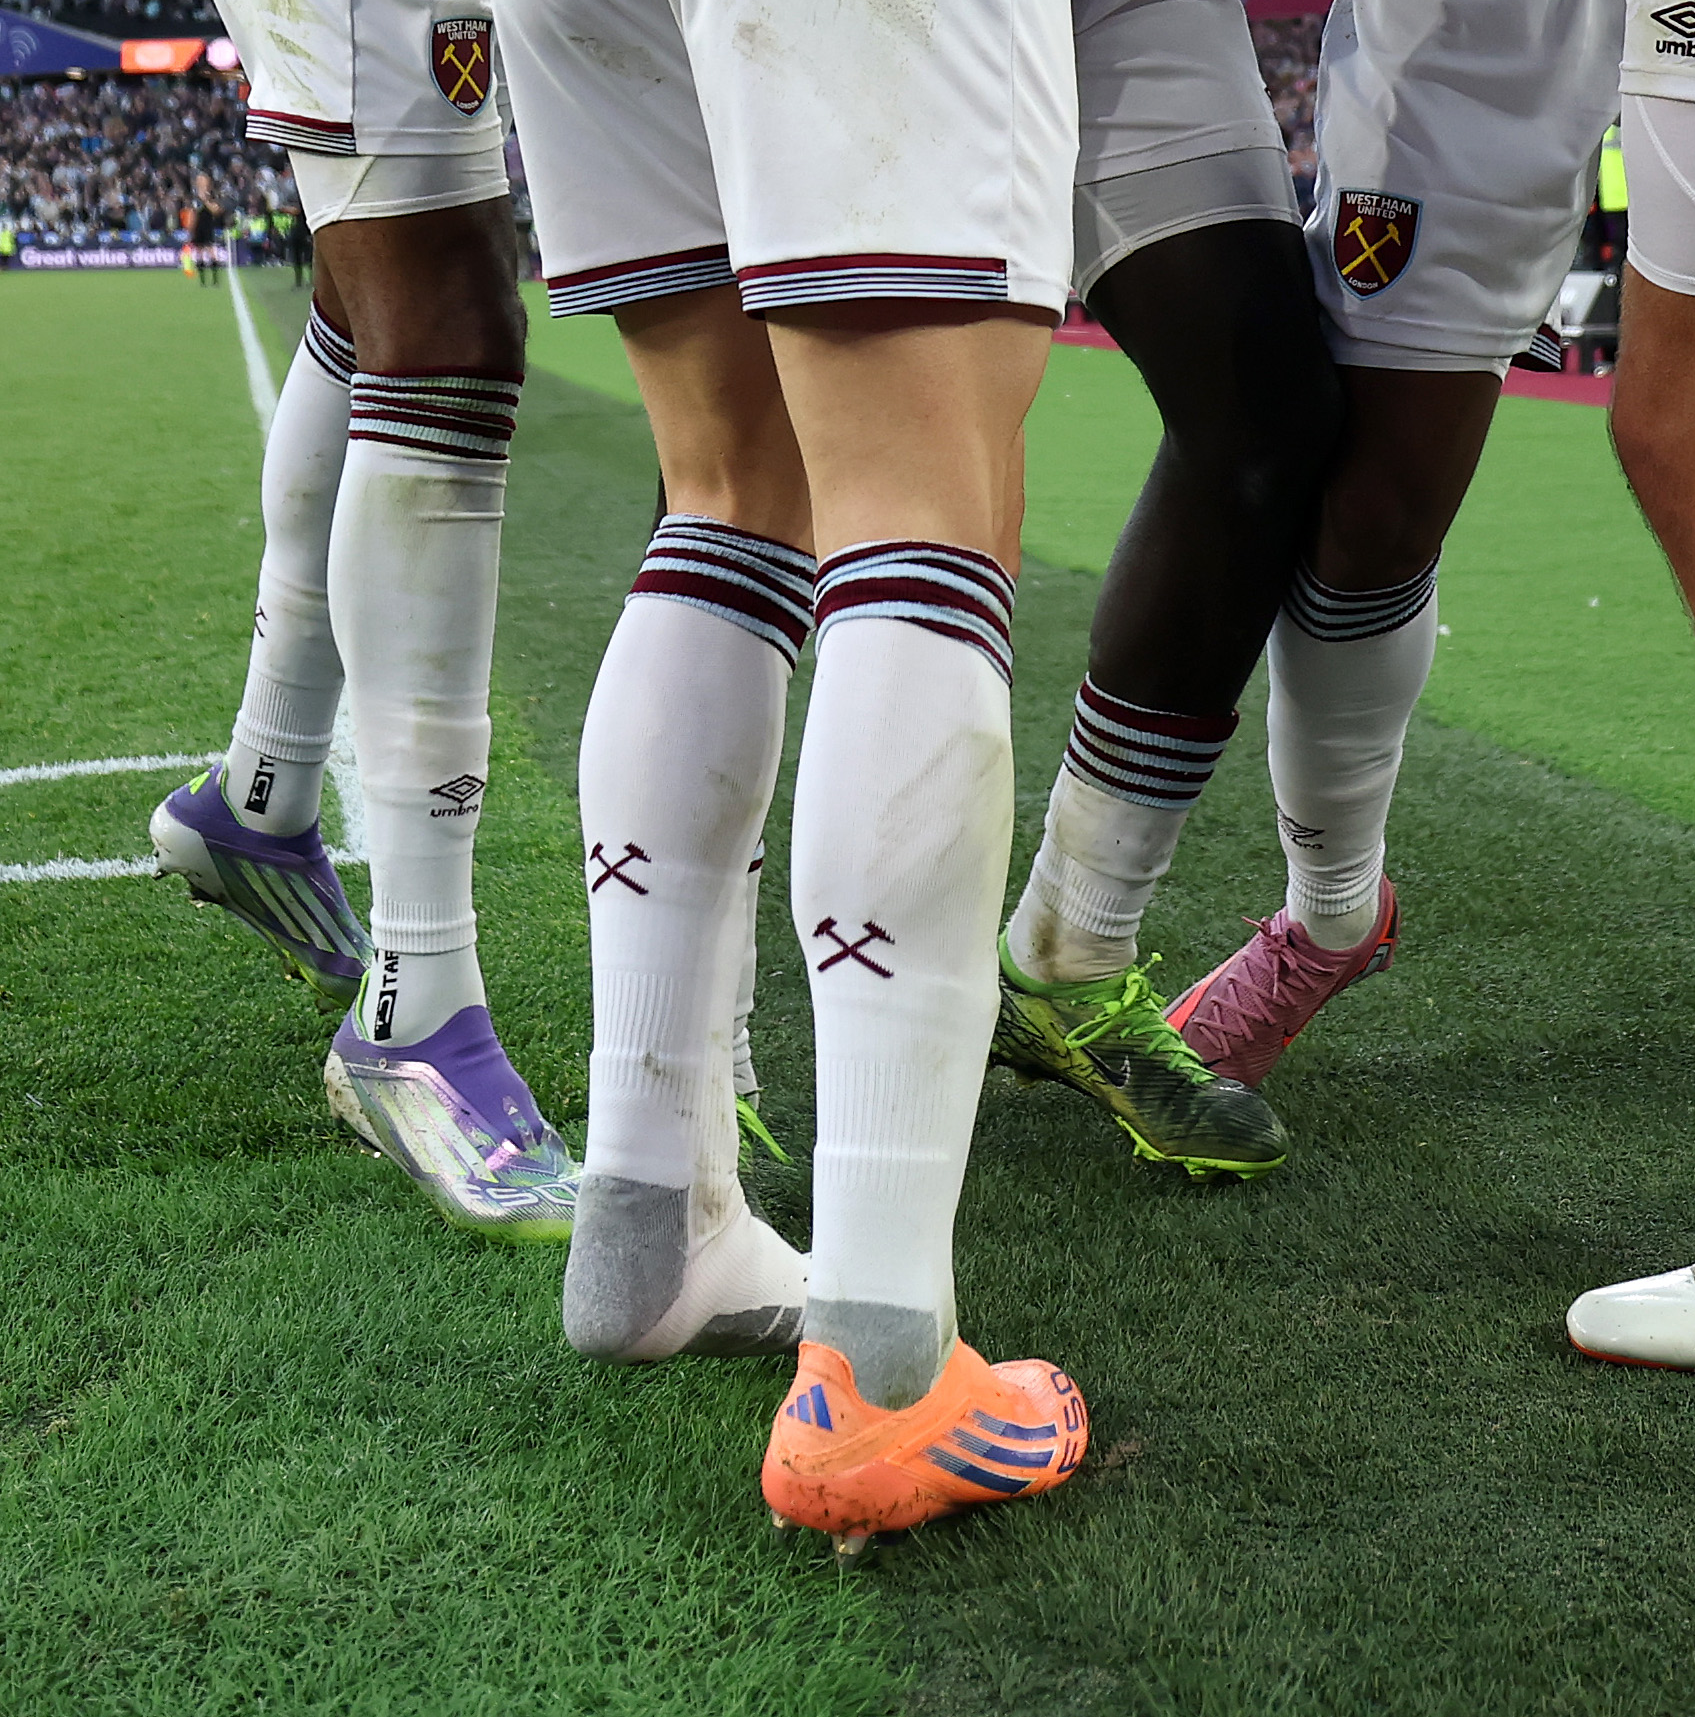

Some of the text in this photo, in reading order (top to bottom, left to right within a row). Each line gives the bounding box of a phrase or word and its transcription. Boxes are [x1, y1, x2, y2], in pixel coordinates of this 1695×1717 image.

[437, 20, 487, 34] WEST HAM
[447, 31, 478, 41] UNITED
[1346, 193, 1412, 216] WEST HAM
[1357, 205, 1397, 220] UNITED
[20, 247, 73, 270] Great
[76, 248, 130, 268] value
[132, 247, 174, 267] data
[1348, 277, 1379, 290] LONDON
[430, 804, 479, 817] umbro
